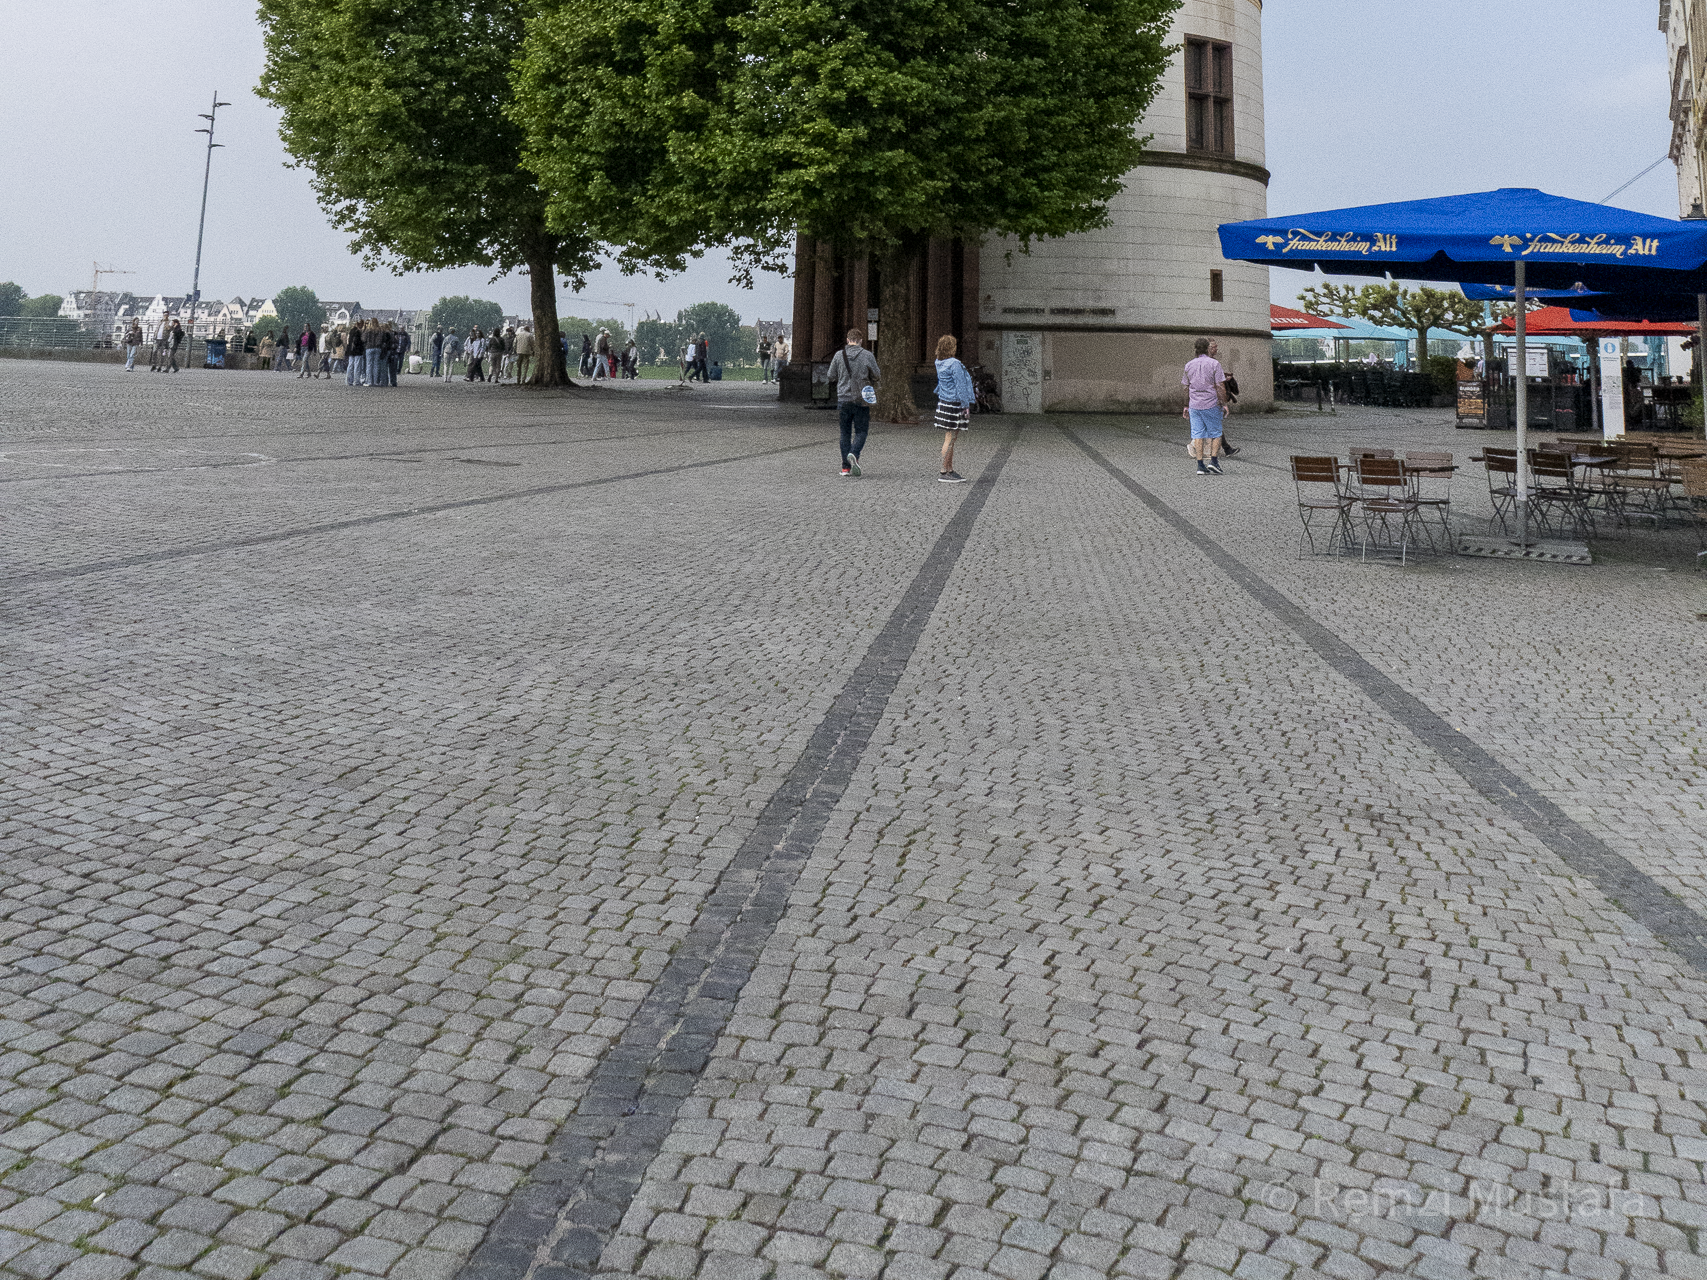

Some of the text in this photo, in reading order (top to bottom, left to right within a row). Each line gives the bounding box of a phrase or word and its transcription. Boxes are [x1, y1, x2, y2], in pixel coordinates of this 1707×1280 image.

[1282, 228, 1398, 254] Frankenheim Alt
[1521, 233, 1659, 258] Frankenheim Alt
